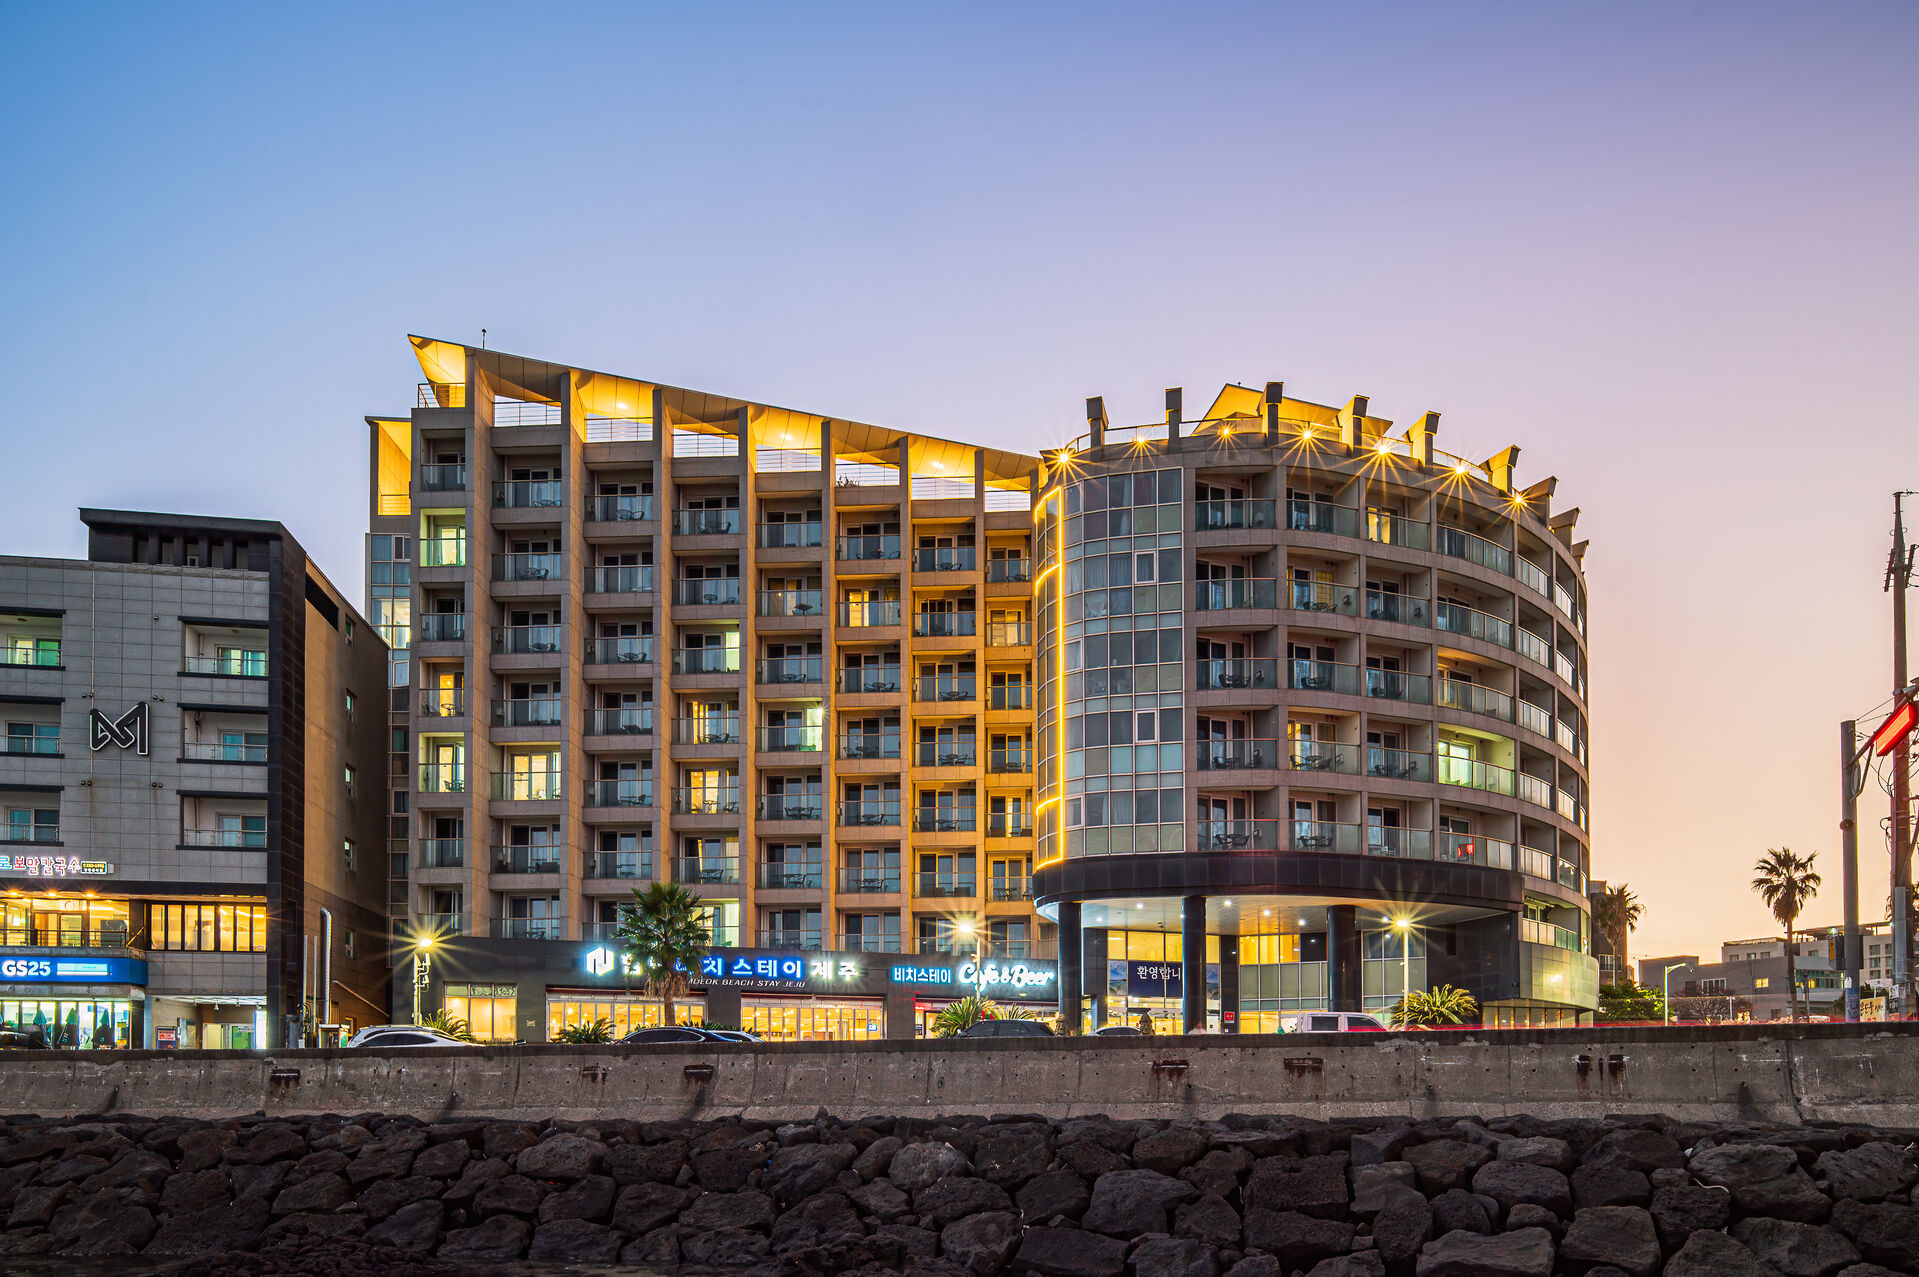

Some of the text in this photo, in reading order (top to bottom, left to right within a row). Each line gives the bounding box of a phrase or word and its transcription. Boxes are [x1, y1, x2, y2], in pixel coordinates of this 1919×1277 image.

[14, 856, 81, 876] 보말칼국수
[2, 960, 51, 976] GS25
[811, 960, 859, 980] 제주
[893, 967, 951, 983] 비치스테이
[1137, 965, 1184, 980] 환영합니
[722, 978, 754, 986] BEACH
[757, 979, 780, 987] STAY
[783, 980, 806, 988] JEJU
